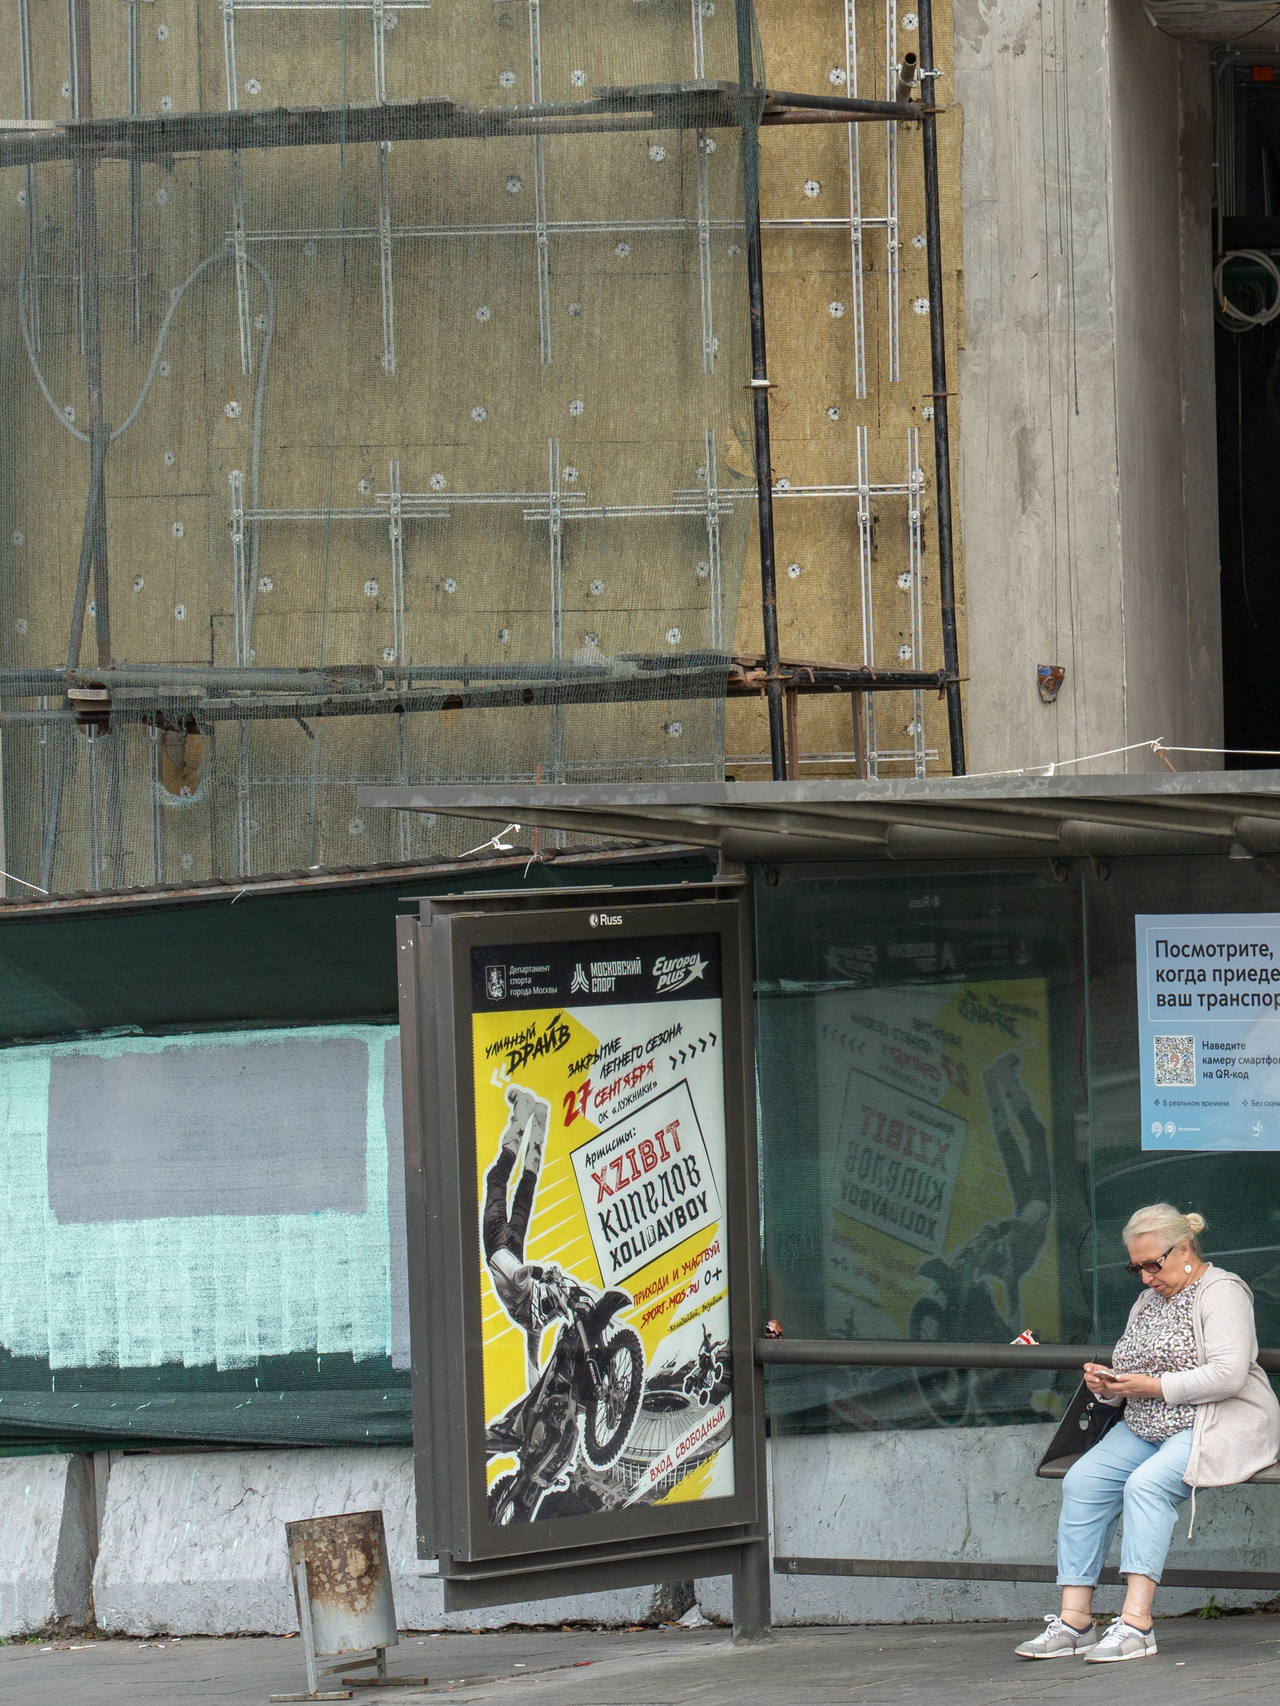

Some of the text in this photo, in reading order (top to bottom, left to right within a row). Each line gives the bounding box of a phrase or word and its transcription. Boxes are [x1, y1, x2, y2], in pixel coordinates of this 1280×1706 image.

[600, 914, 622, 926] Russ
[1155, 940, 1274, 961] Посмотрите,
[509, 965, 550, 975] Департамент
[590, 957, 642, 977] МОСКОВСКИЙ
[1156, 968, 1207, 985] когда
[509, 986, 558, 997] города Москвы
[510, 977, 532, 986] спорта
[591, 977, 616, 993] СПОРТ
[1156, 993, 1193, 1007] ваш
[485, 1021, 537, 1059] УЛИЧНЫЙ
[504, 1011, 571, 1077] ДРАЙВ
[600, 1022, 683, 1080] ЛЕТНЕГО СЕЗОНА
[1202, 1040, 1246, 1052] Наведите
[567, 1037, 622, 1079] ЗАКРЫТИЕ
[1202, 1056, 1236, 1067] камеру
[1202, 1068, 1249, 1081] на QR-код
[563, 1057, 656, 1128] 27 СЕНТЯБРЯ
[611, 1081, 658, 1115] «ЛУЖНИКИ»
[585, 1127, 637, 1169] Артисты:
[591, 1119, 681, 1204] XZIBIT
[609, 1190, 709, 1272] XOLIDAYBOY
[633, 1240, 721, 1307] ПРИХОДИ И УЧАСТВУЙ
[640, 1267, 722, 1329] SPORT.MOS.RU 0+
[650, 1404, 726, 1482] ВХОД СВОБОДНЫЙ
